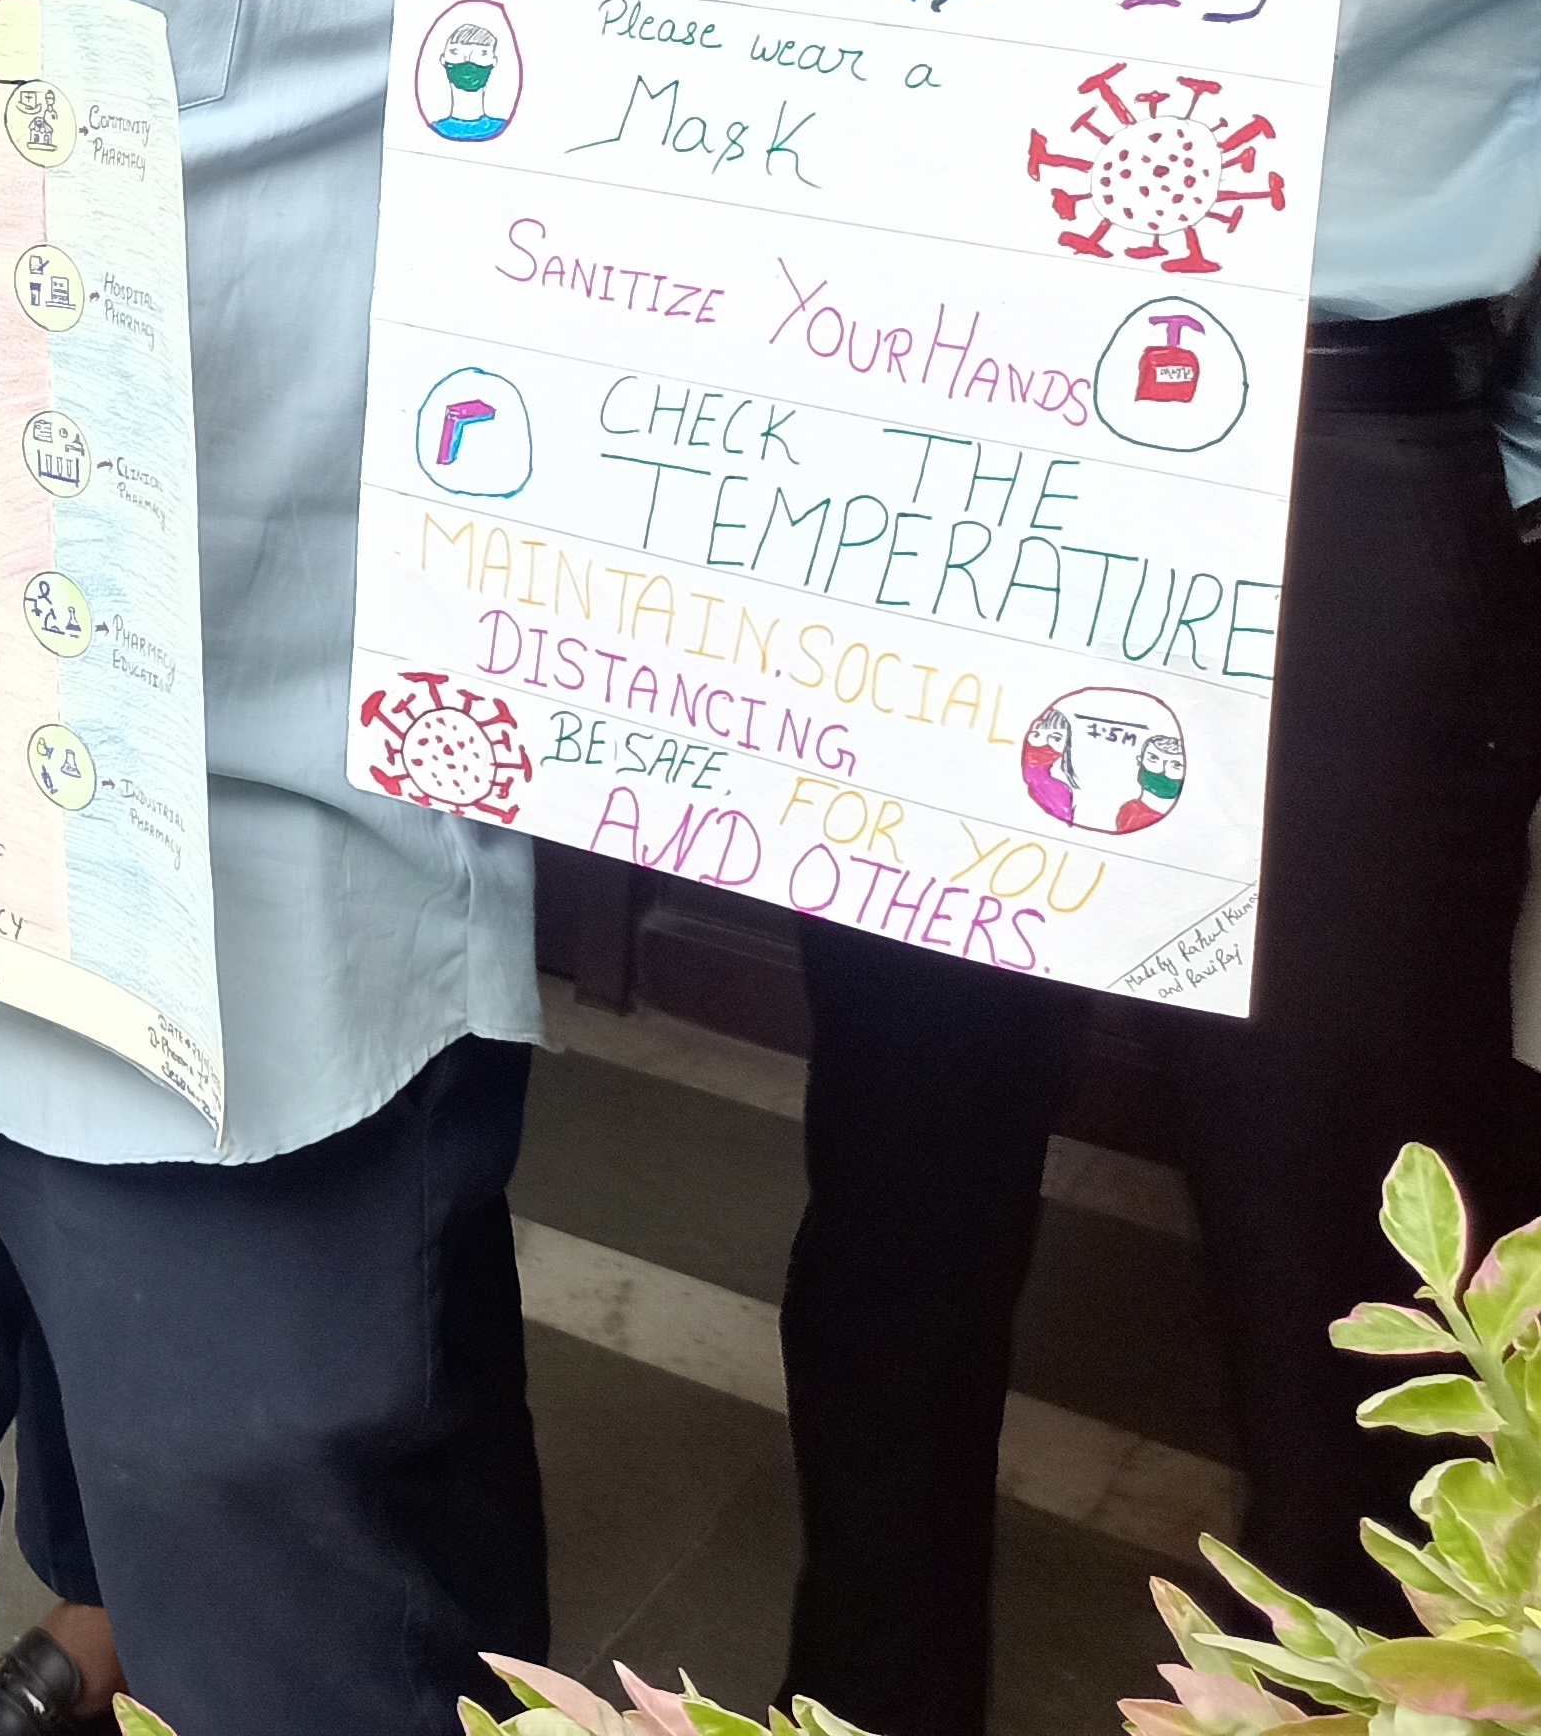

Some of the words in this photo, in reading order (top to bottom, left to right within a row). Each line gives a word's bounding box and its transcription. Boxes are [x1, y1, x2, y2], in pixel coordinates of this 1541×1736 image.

[748, 36, 869, 84] wear
[904, 59, 942, 90] a
[494, 217, 725, 325] SANITIZE
[598, 375, 800, 465] CHECK
[882, 426, 1081, 532] THE
[599, 450, 1283, 680] TEMPERATURE
[478, 609, 859, 778] DISTANCING
[588, 785, 765, 887] AND
[779, 775, 906, 864] FOR
[949, 816, 1107, 917] YOU
